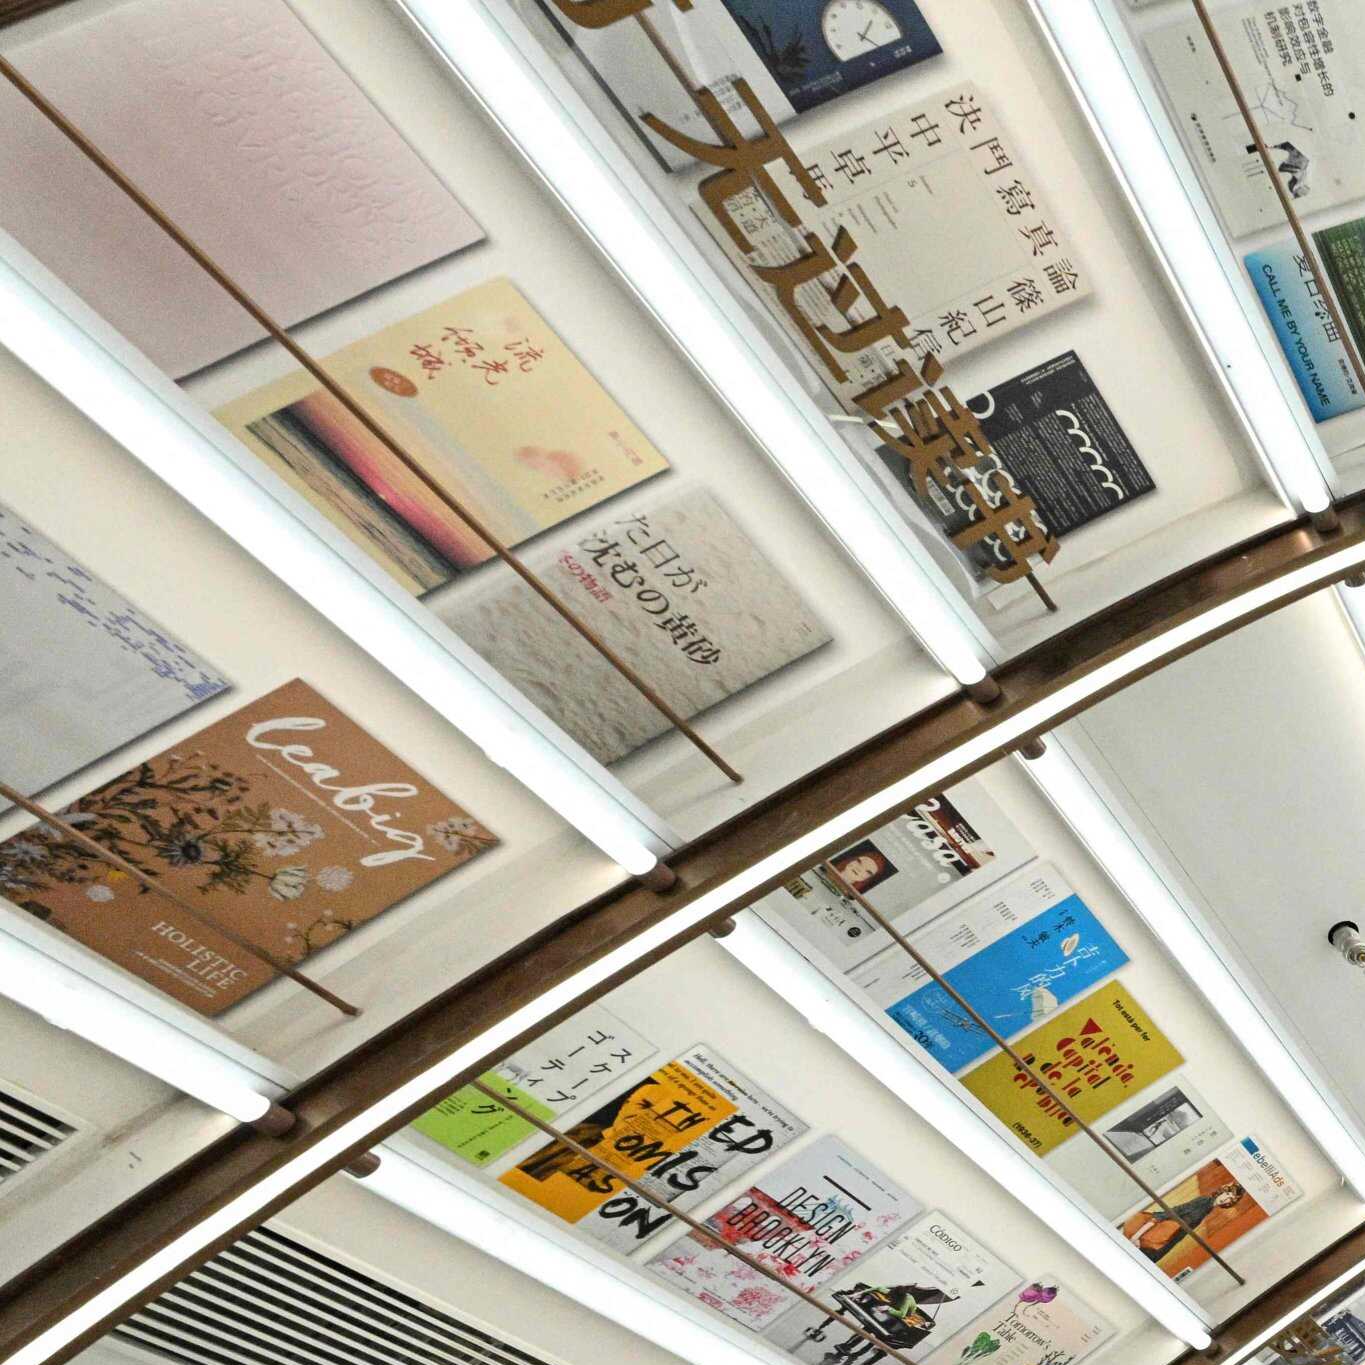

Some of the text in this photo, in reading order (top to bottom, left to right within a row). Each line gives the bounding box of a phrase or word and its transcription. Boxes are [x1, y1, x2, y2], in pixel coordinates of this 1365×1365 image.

[1261, 263, 1283, 303] CALL
[1294, 330, 1317, 370] YOUR
[1308, 366, 1332, 408] NAME
[150, 920, 248, 980] HOLISTIC
[187, 958, 234, 994] LIFE
[707, 1112, 774, 1157] ED
[600, 1195, 675, 1241] ON
[726, 1202, 842, 1278] BROOKLYN
[778, 1185, 857, 1249] DESIGN
[927, 1222, 964, 1255] CÓDIGO
[990, 1322, 1018, 1350] Table
